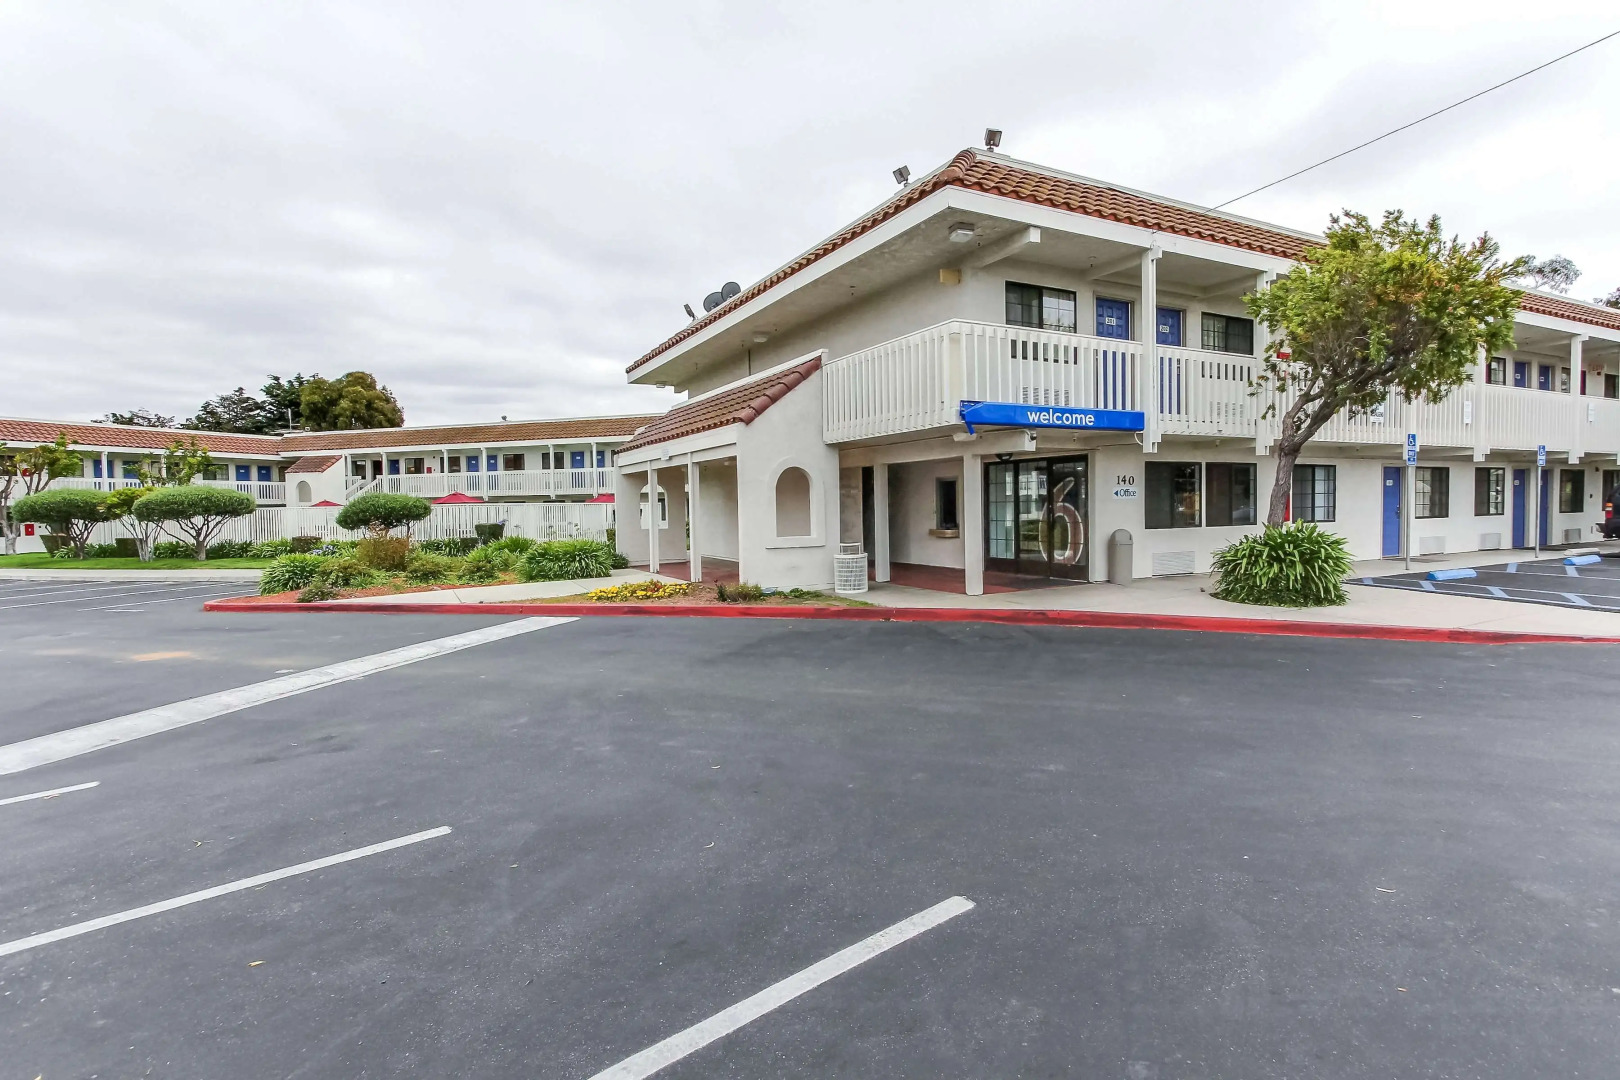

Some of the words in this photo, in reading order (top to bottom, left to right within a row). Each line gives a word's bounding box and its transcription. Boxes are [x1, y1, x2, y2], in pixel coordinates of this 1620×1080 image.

[1027, 408, 1095, 426] welcome
[1116, 474, 1135, 486] 140
[1119, 488, 1137, 497] Office
[1038, 476, 1084, 566] 6
